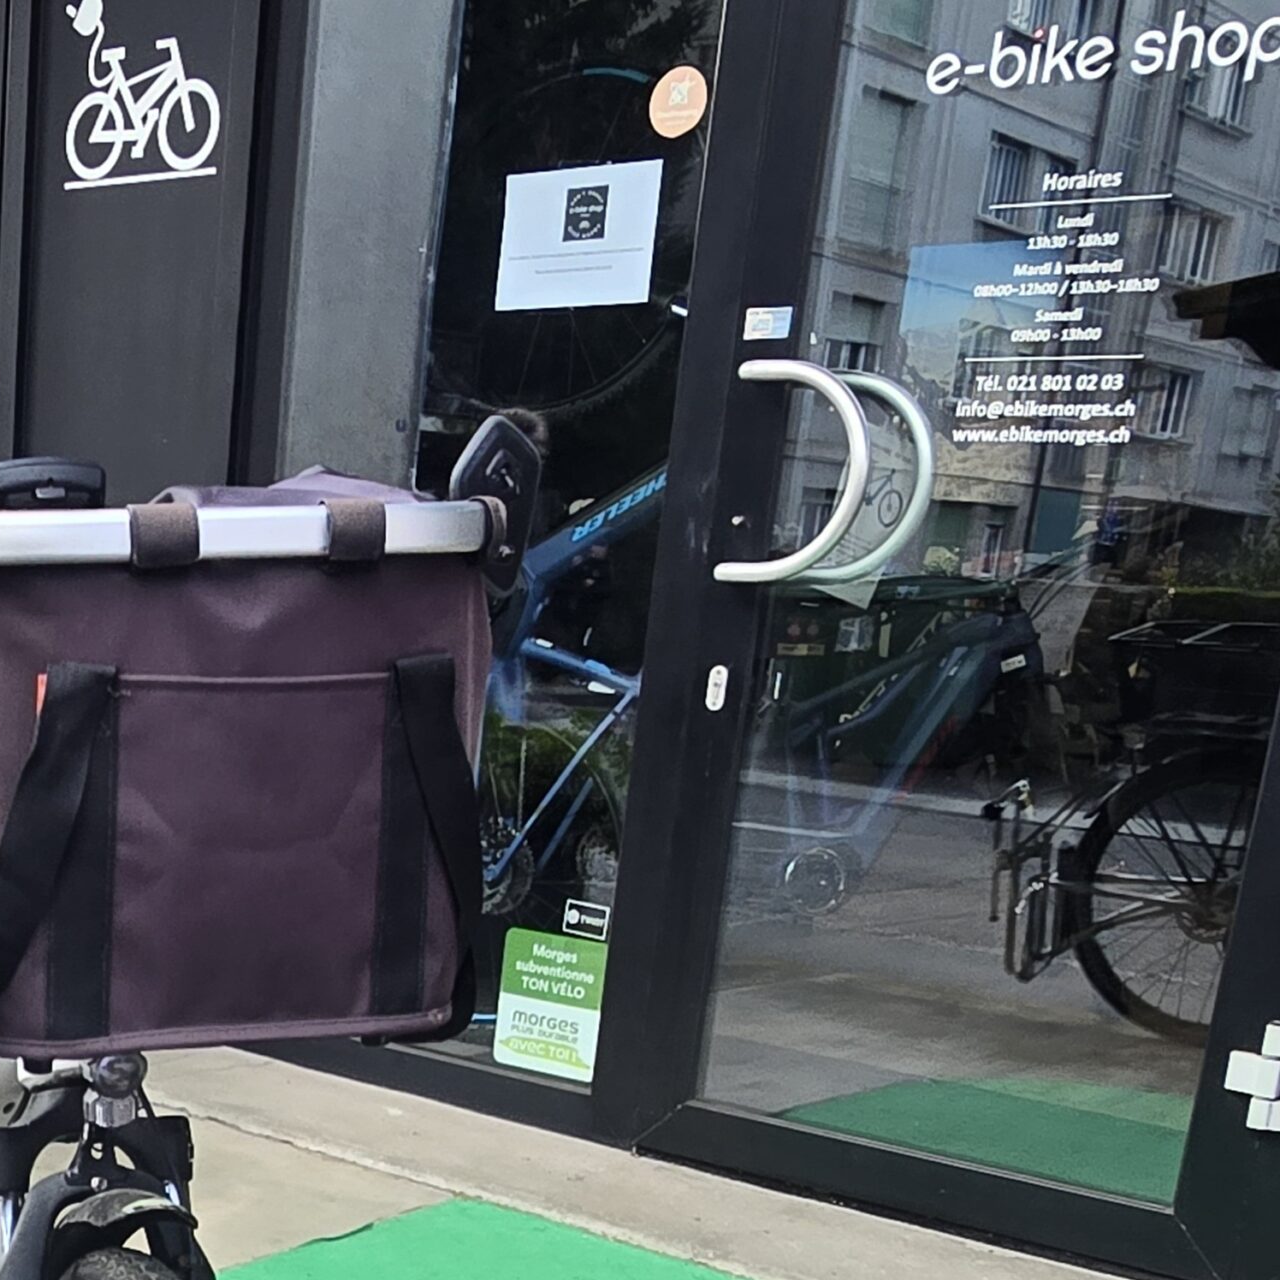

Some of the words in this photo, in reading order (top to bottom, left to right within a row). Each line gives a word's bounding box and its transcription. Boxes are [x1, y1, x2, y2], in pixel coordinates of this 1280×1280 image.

[926, 25, 1114, 95] e-bike
[1131, 10, 1280, 82] shop
[1043, 170, 1122, 192] Horaires
[1057, 213, 1094, 229] Lundi
[1027, 235, 1067, 249] 13h30
[1013, 262, 1052, 276] Mardi
[1065, 259, 1123, 275] vendredi
[1034, 307, 1083, 322] Samedi
[975, 375, 1003, 391] Tél.
[1007, 375, 1037, 391] 021
[1040, 374, 1071, 391] 801
[1076, 374, 1097, 390] 02
[1101, 373, 1124, 390] 03
[955, 399, 1136, 420] info@ebikemorges.ch
[952, 425, 1131, 446] www.ebikemorges.ch
[572, 472, 667, 541] HEELER
[533, 943, 577, 964] Morges
[515, 959, 594, 984] subventionne
[522, 976, 549, 993] TON
[551, 980, 585, 999] VÉLO
